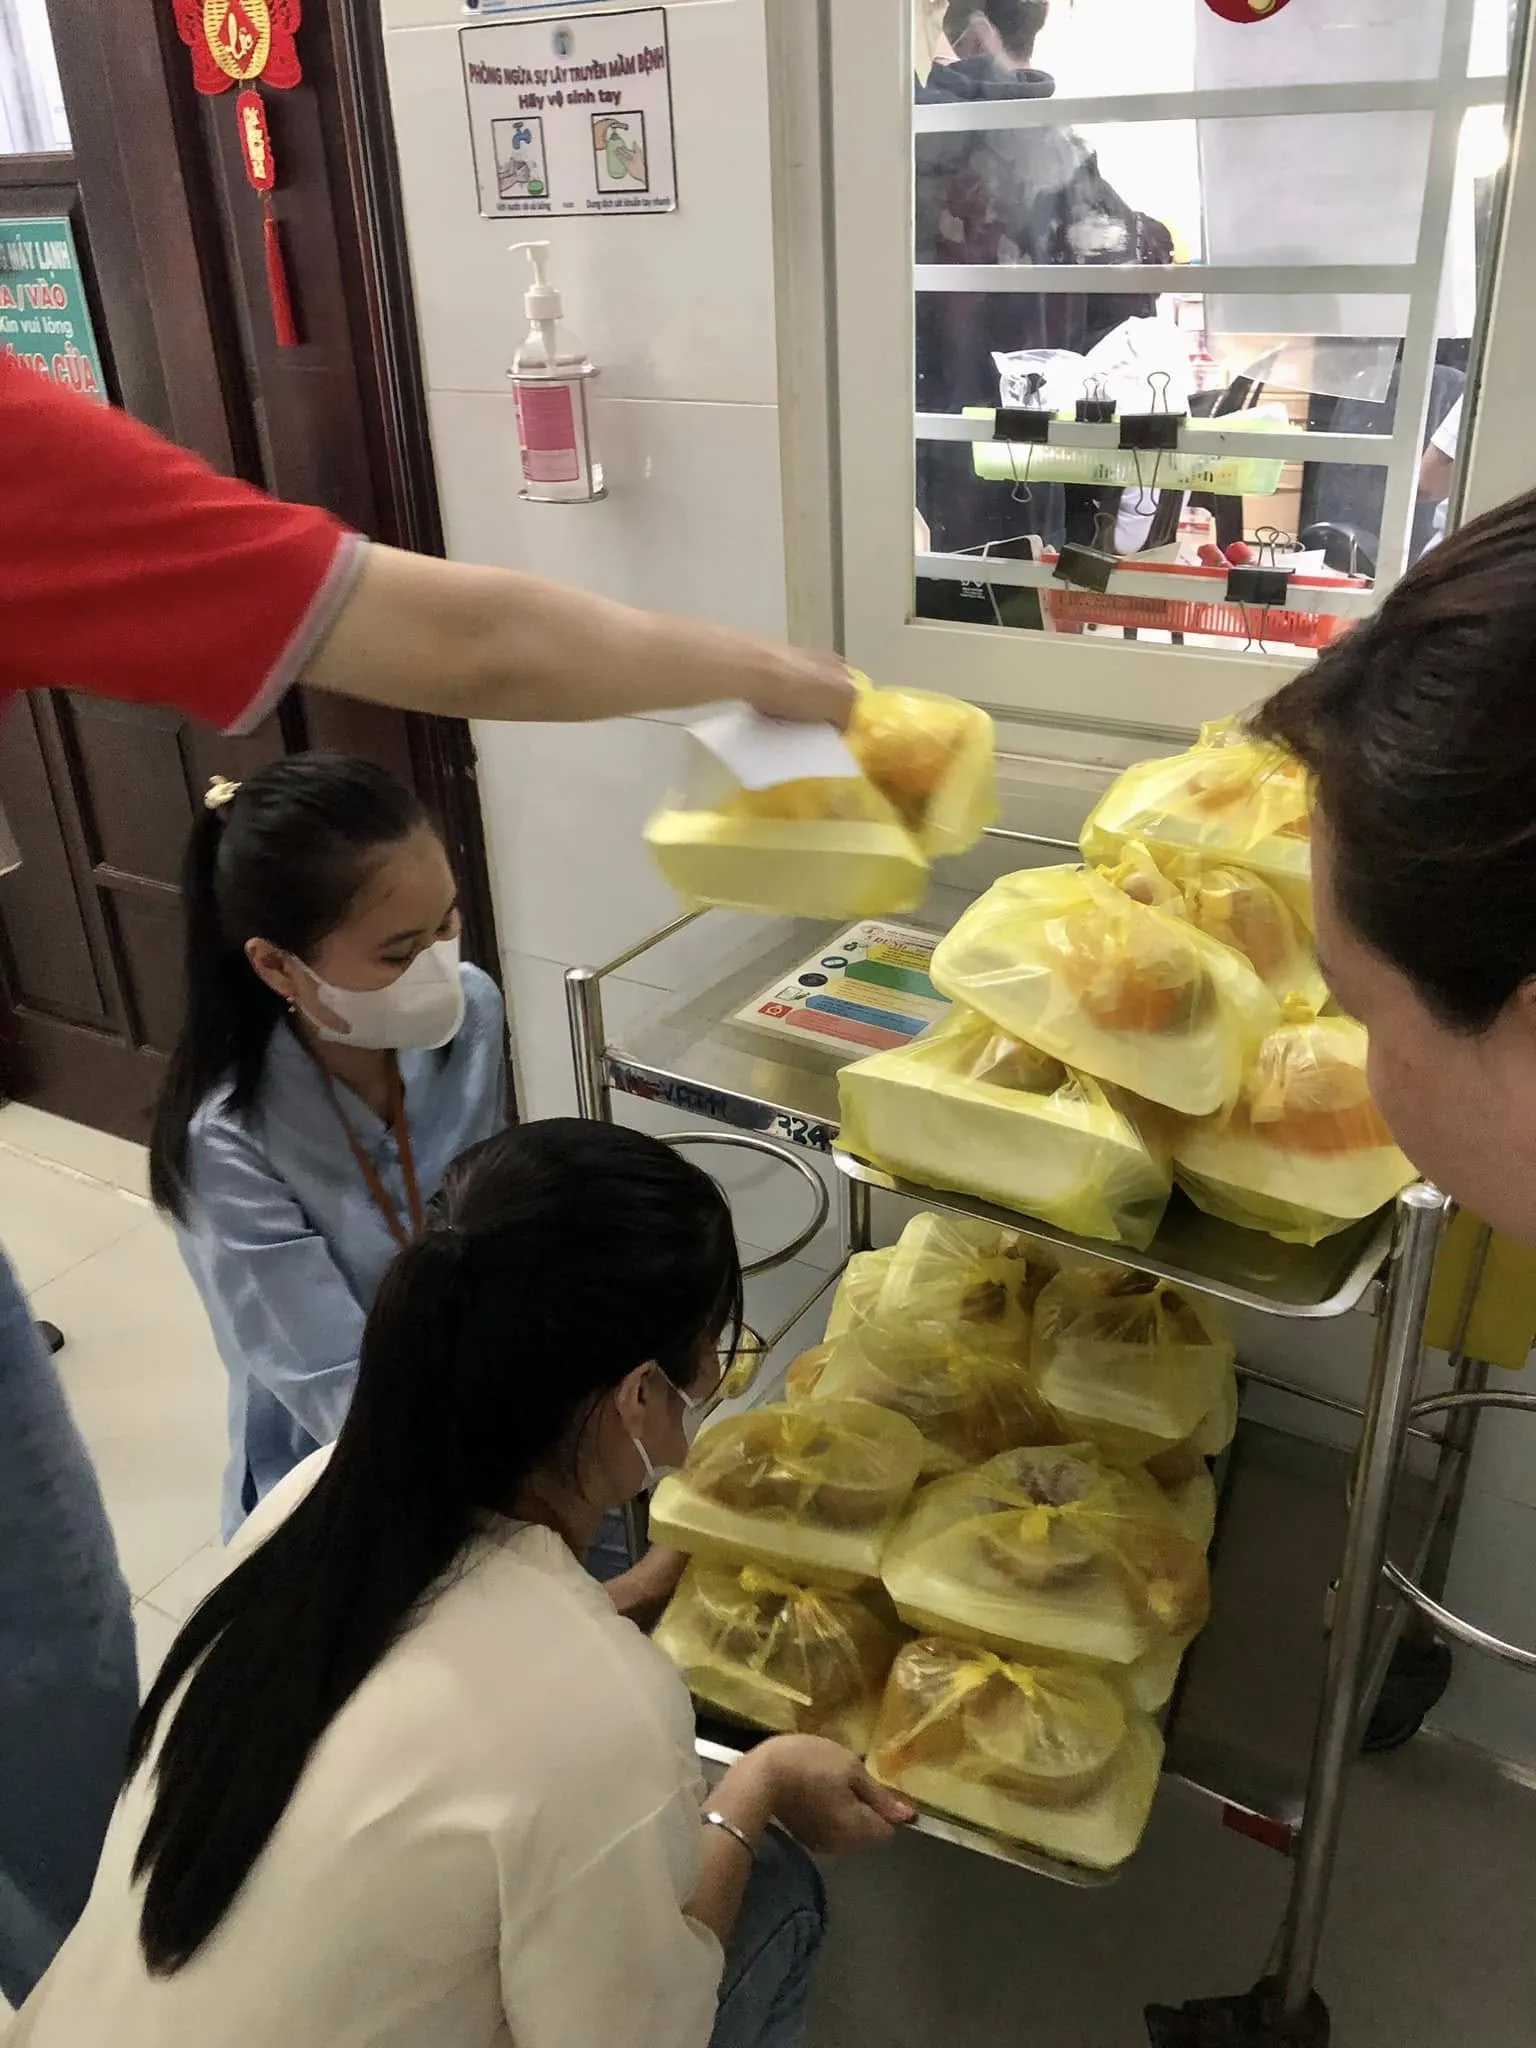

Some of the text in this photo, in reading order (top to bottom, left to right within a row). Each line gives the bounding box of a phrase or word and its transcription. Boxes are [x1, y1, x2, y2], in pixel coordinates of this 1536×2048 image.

[467, 45, 664, 88] PHÒNG NGỪA SỰ LÂY TRUYỀN MẦM BỆNH
[518, 88, 621, 111] Hãy vệ sinh tay
[7, 233, 36, 270] MÁY
[34, 240, 72, 279] LẠNH
[20, 316, 42, 333] vui
[41, 316, 74, 338] lòng
